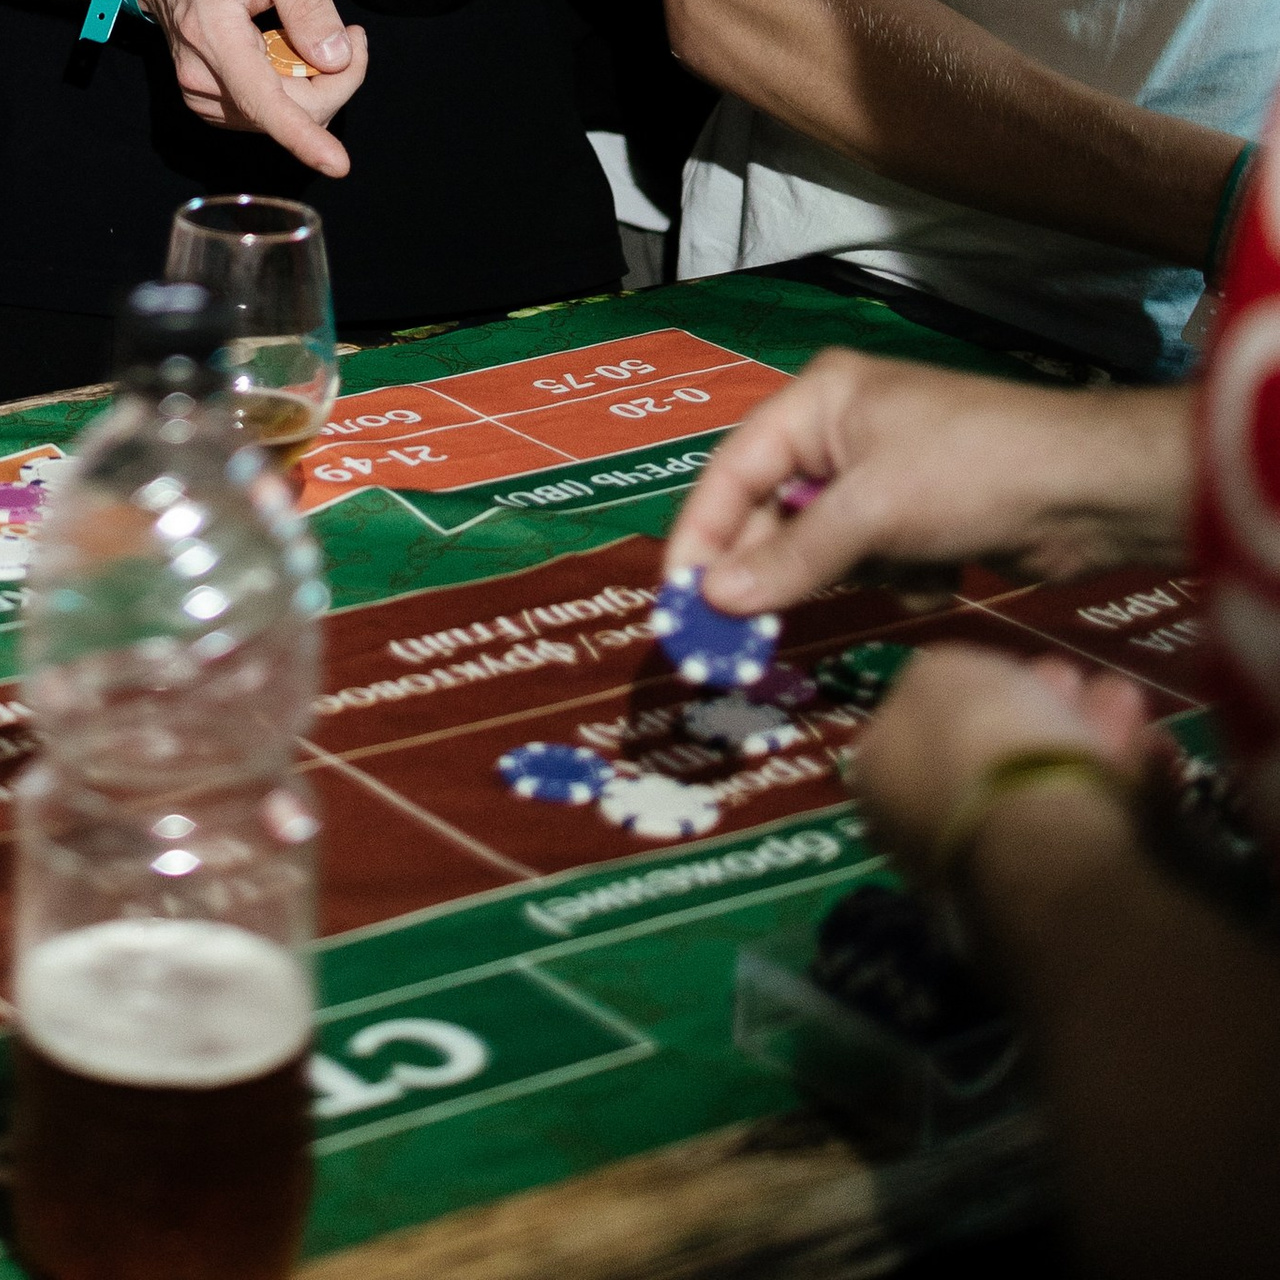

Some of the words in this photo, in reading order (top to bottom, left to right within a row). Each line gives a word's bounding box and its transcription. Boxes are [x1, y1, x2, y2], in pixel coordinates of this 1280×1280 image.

[533, 359, 657, 394] 50-75
[609, 388, 711, 419] 0-20
[314, 445, 448, 482] 21-49
[591, 451, 715, 488] ОРЕЧЬ
[493, 481, 595, 508] (IBU)
